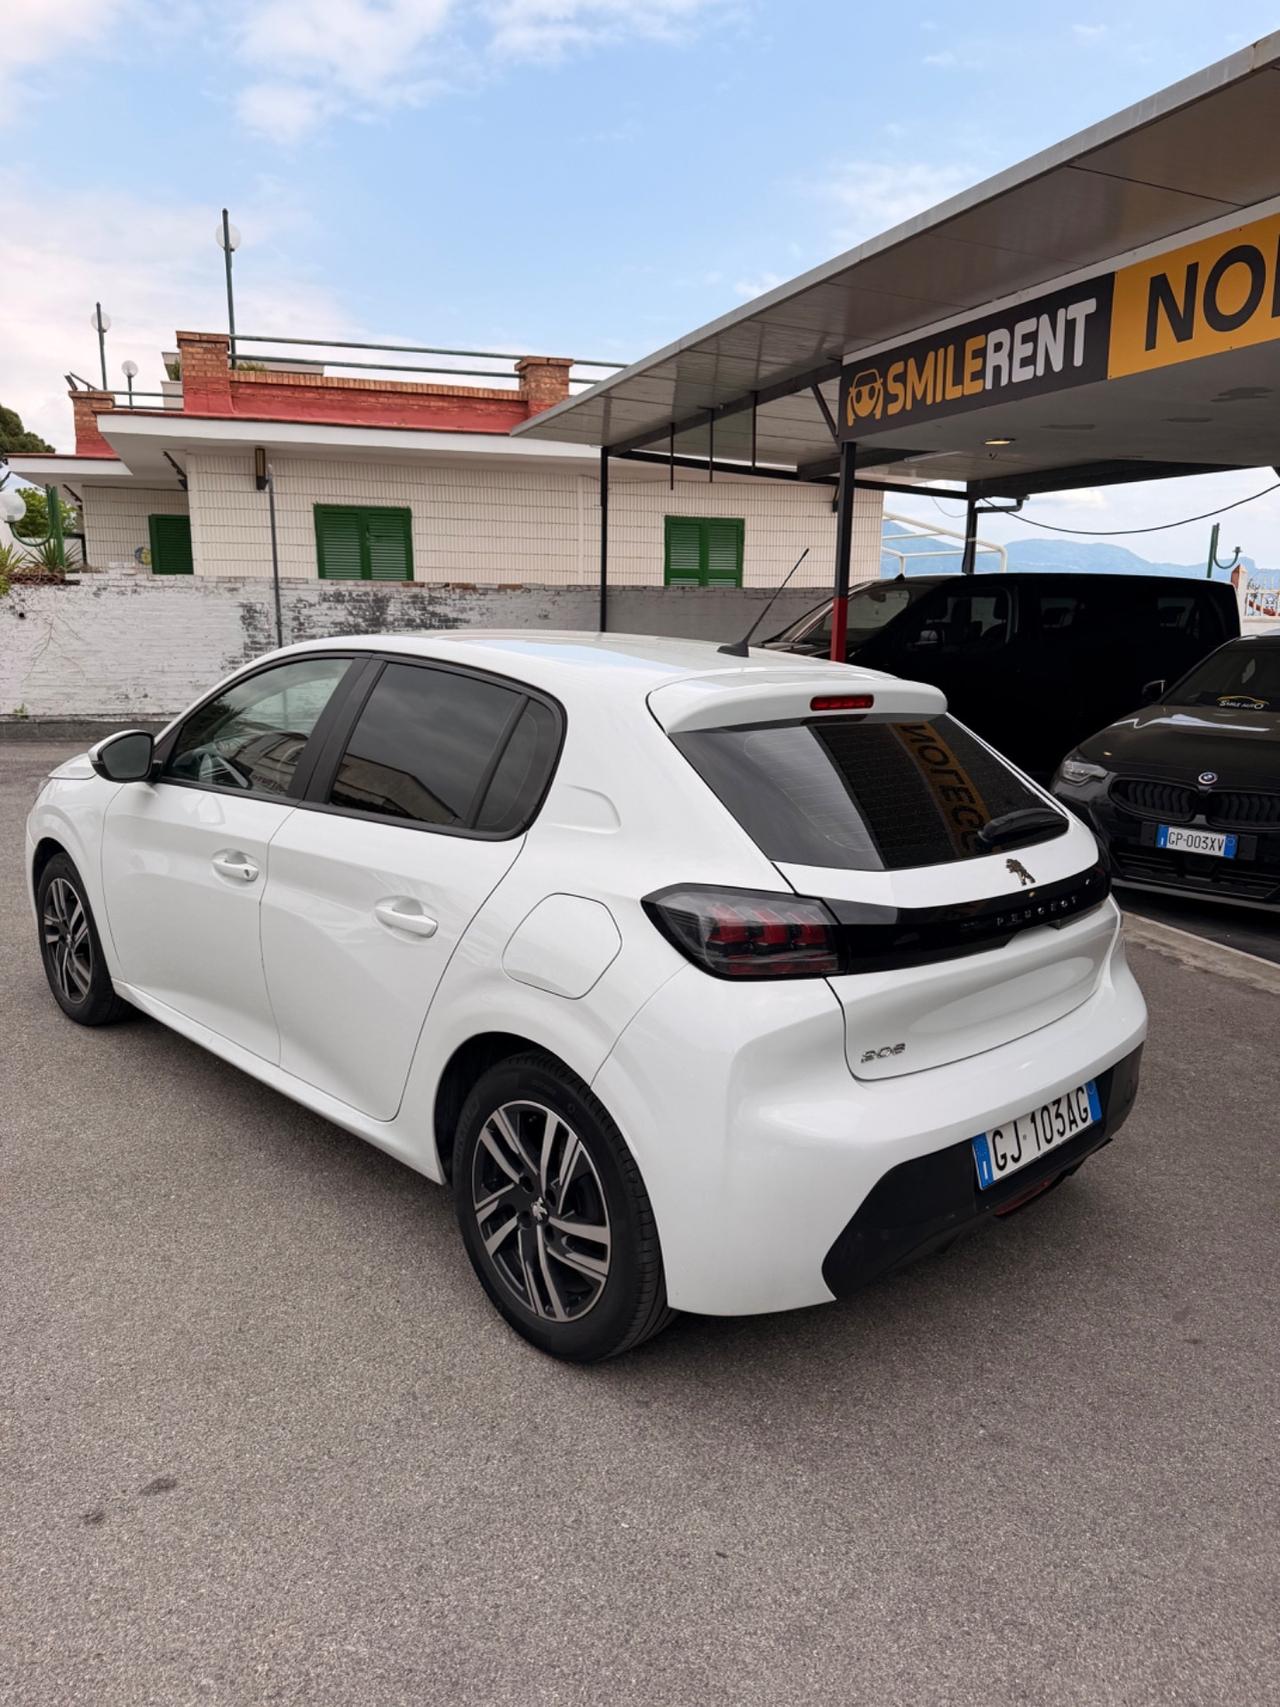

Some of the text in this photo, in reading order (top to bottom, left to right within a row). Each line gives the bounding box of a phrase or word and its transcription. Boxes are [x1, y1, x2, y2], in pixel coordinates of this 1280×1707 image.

[1145, 235, 1280, 351] NO
[887, 298, 1097, 416] SMILERENT
[860, 1043, 906, 1063] 208
